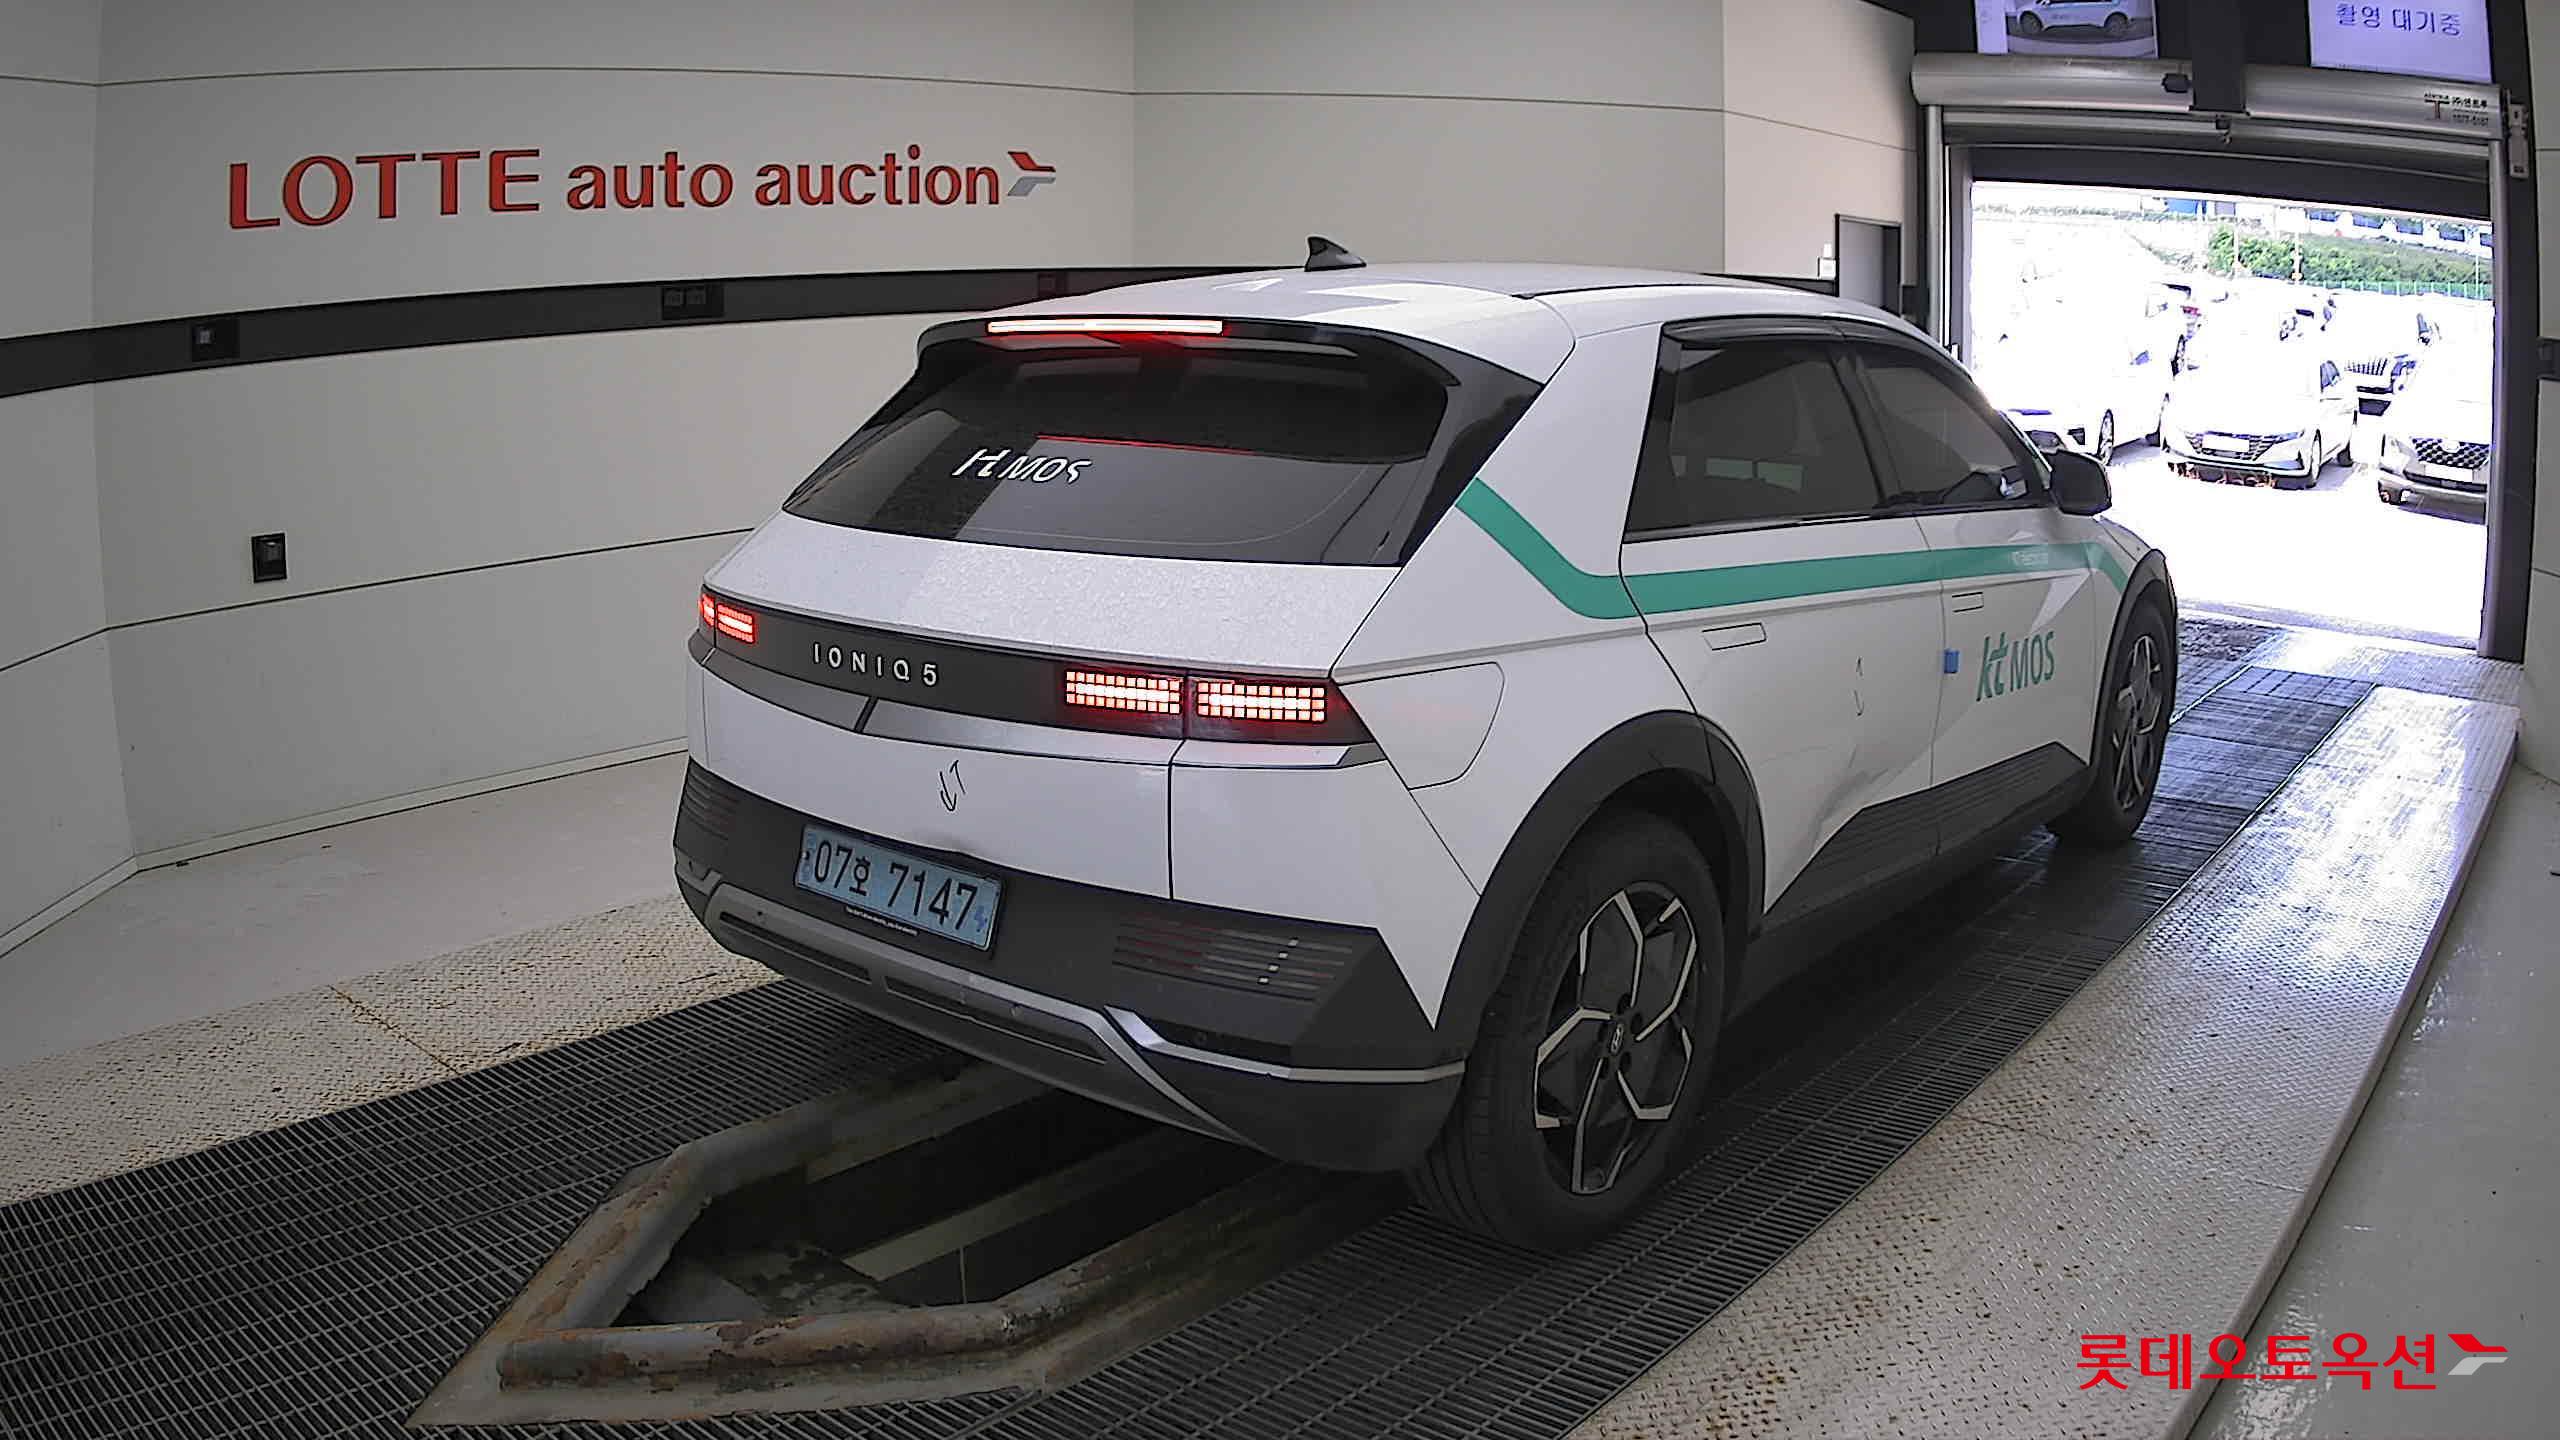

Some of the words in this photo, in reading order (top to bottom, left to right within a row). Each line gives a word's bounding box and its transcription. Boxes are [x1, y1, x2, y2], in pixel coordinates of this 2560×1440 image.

[2336, 3, 2382, 29] 촬영
[2391, 8, 2461, 36] 대기중
[229, 148, 541, 230] LOTTE
[566, 150, 735, 211] auto
[755, 144, 1000, 208] auction
[813, 643, 910, 682] IONIQ
[923, 663, 938, 687] 5
[1976, 631, 2009, 702] kt
[2010, 631, 2055, 692] MOS
[813, 840, 872, 897] 07호
[887, 861, 979, 930] 7147
